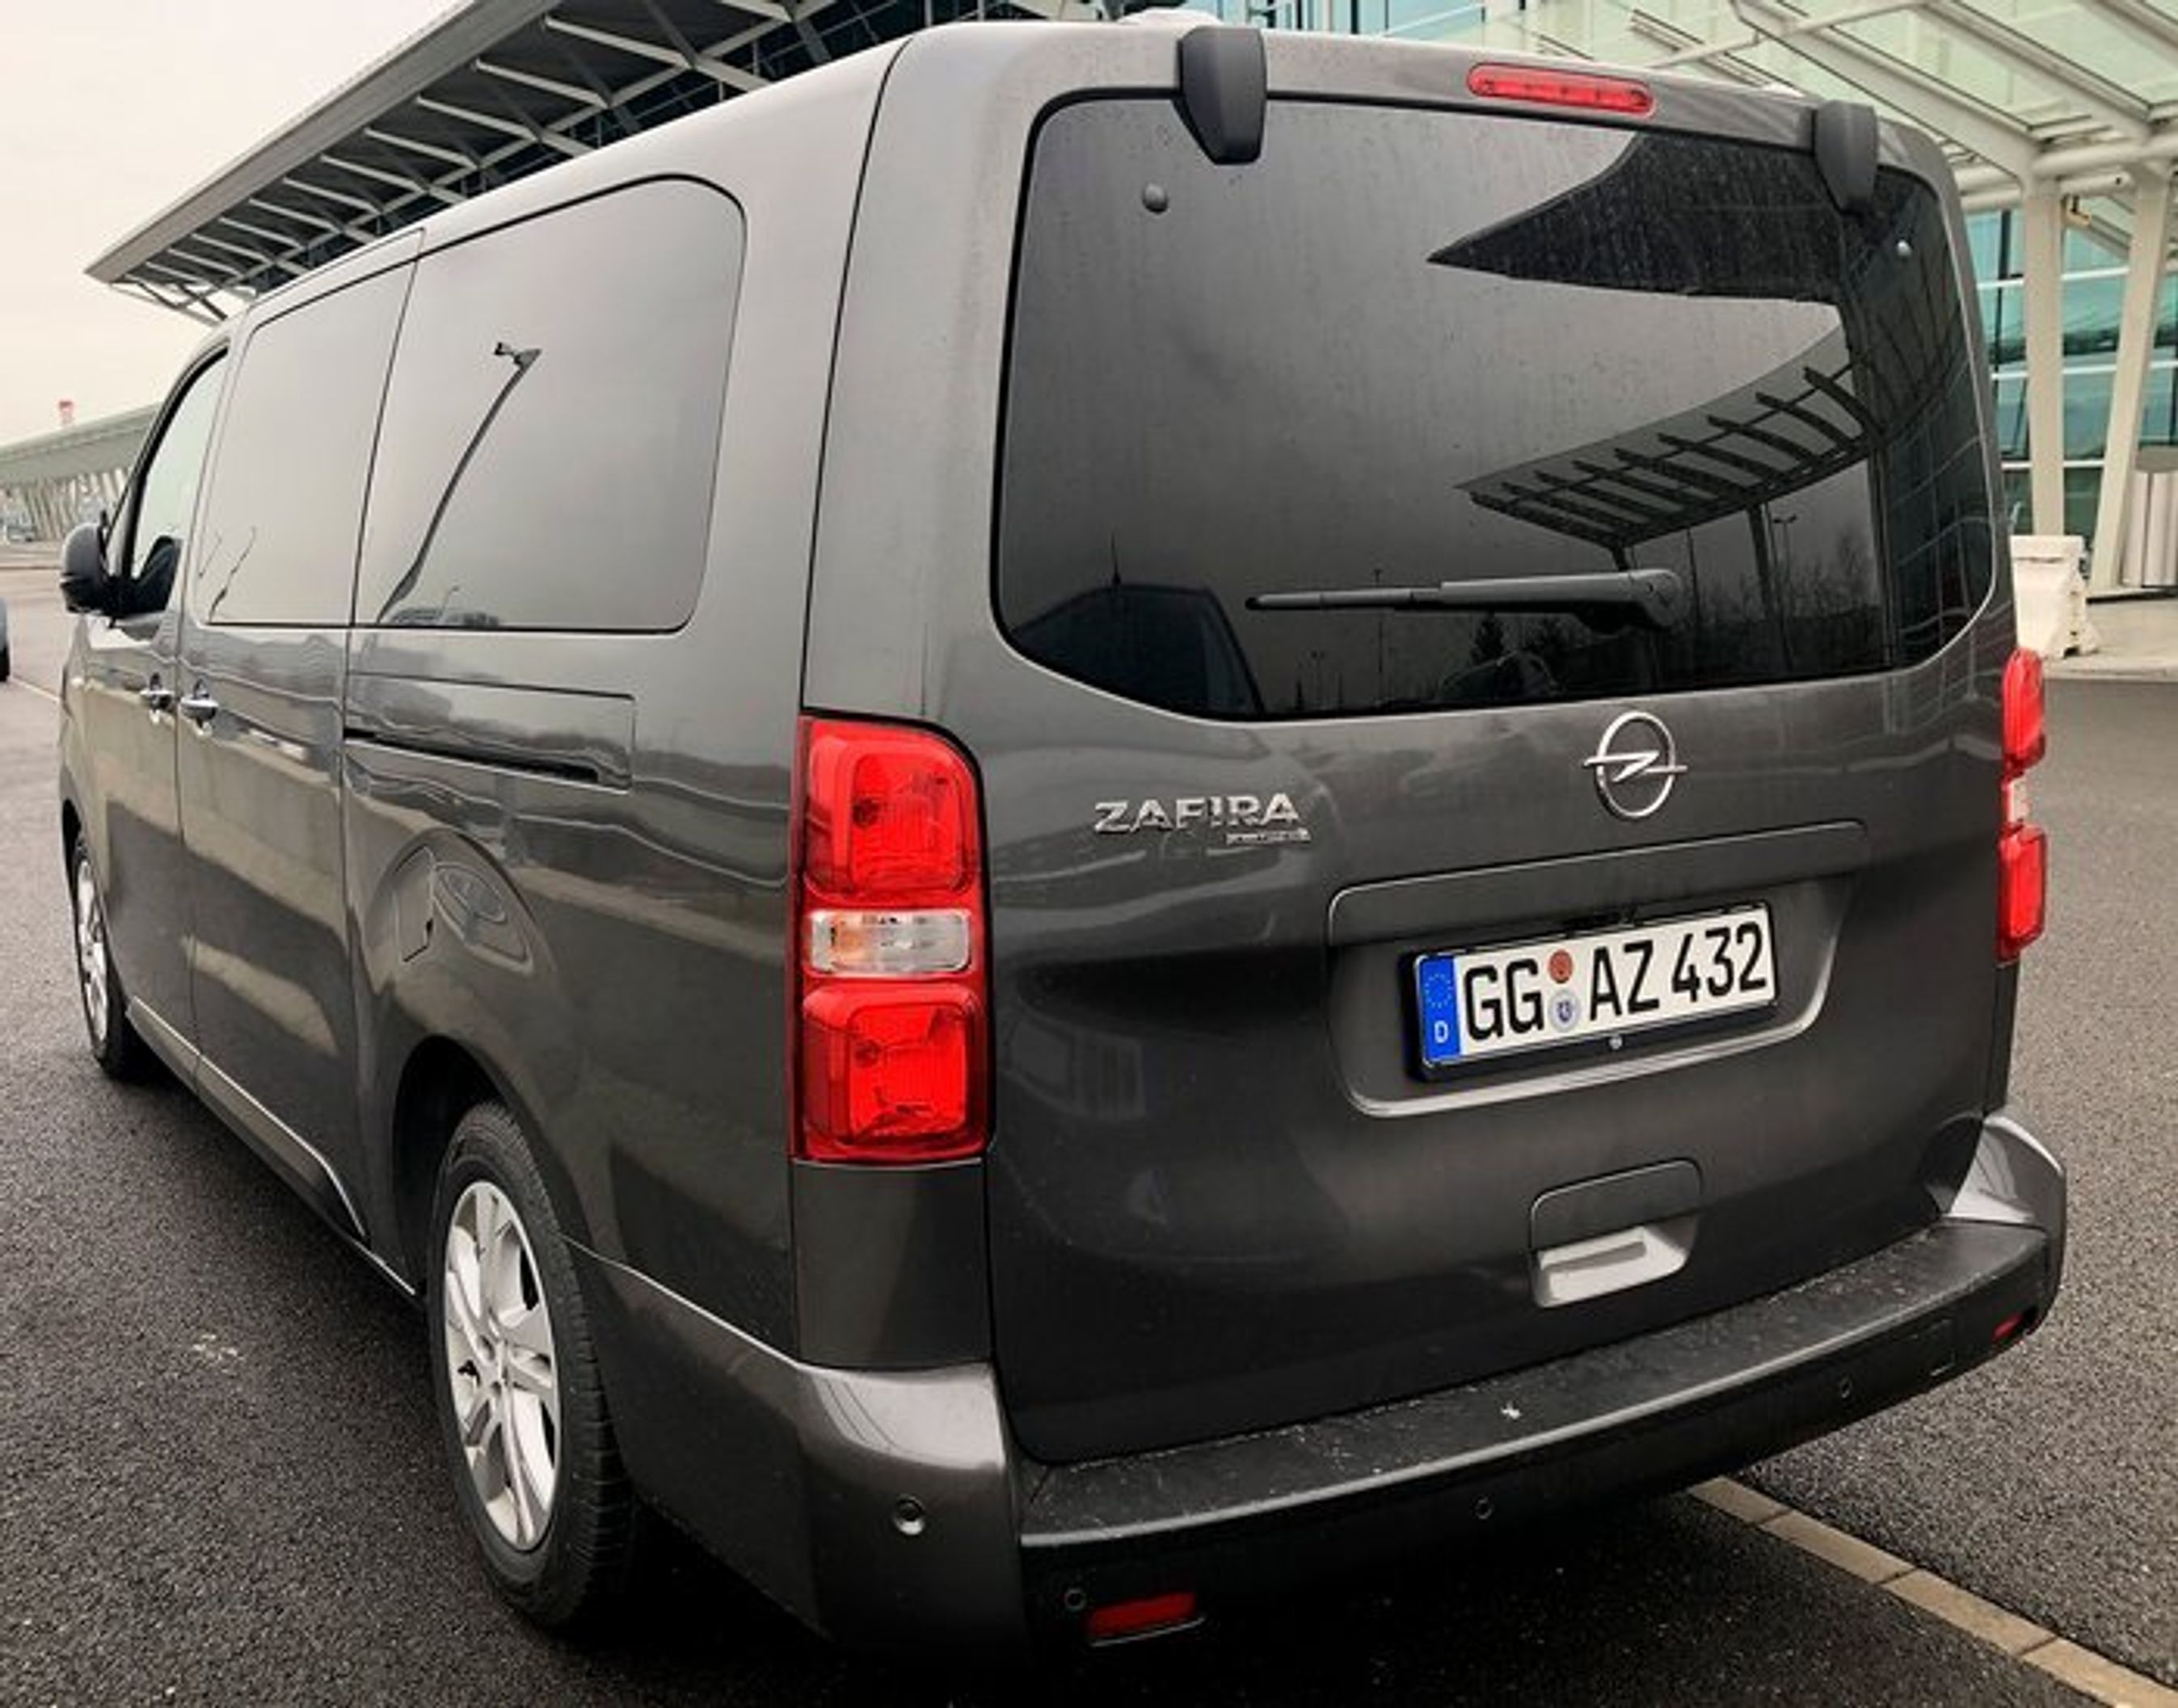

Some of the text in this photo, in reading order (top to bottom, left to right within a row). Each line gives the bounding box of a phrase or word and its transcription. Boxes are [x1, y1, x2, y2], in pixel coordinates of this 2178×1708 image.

[1095, 793, 1299, 832] ZAFIRA
[1463, 922, 1766, 1041] GG AZ 432
[1434, 1020, 1449, 1044] D
